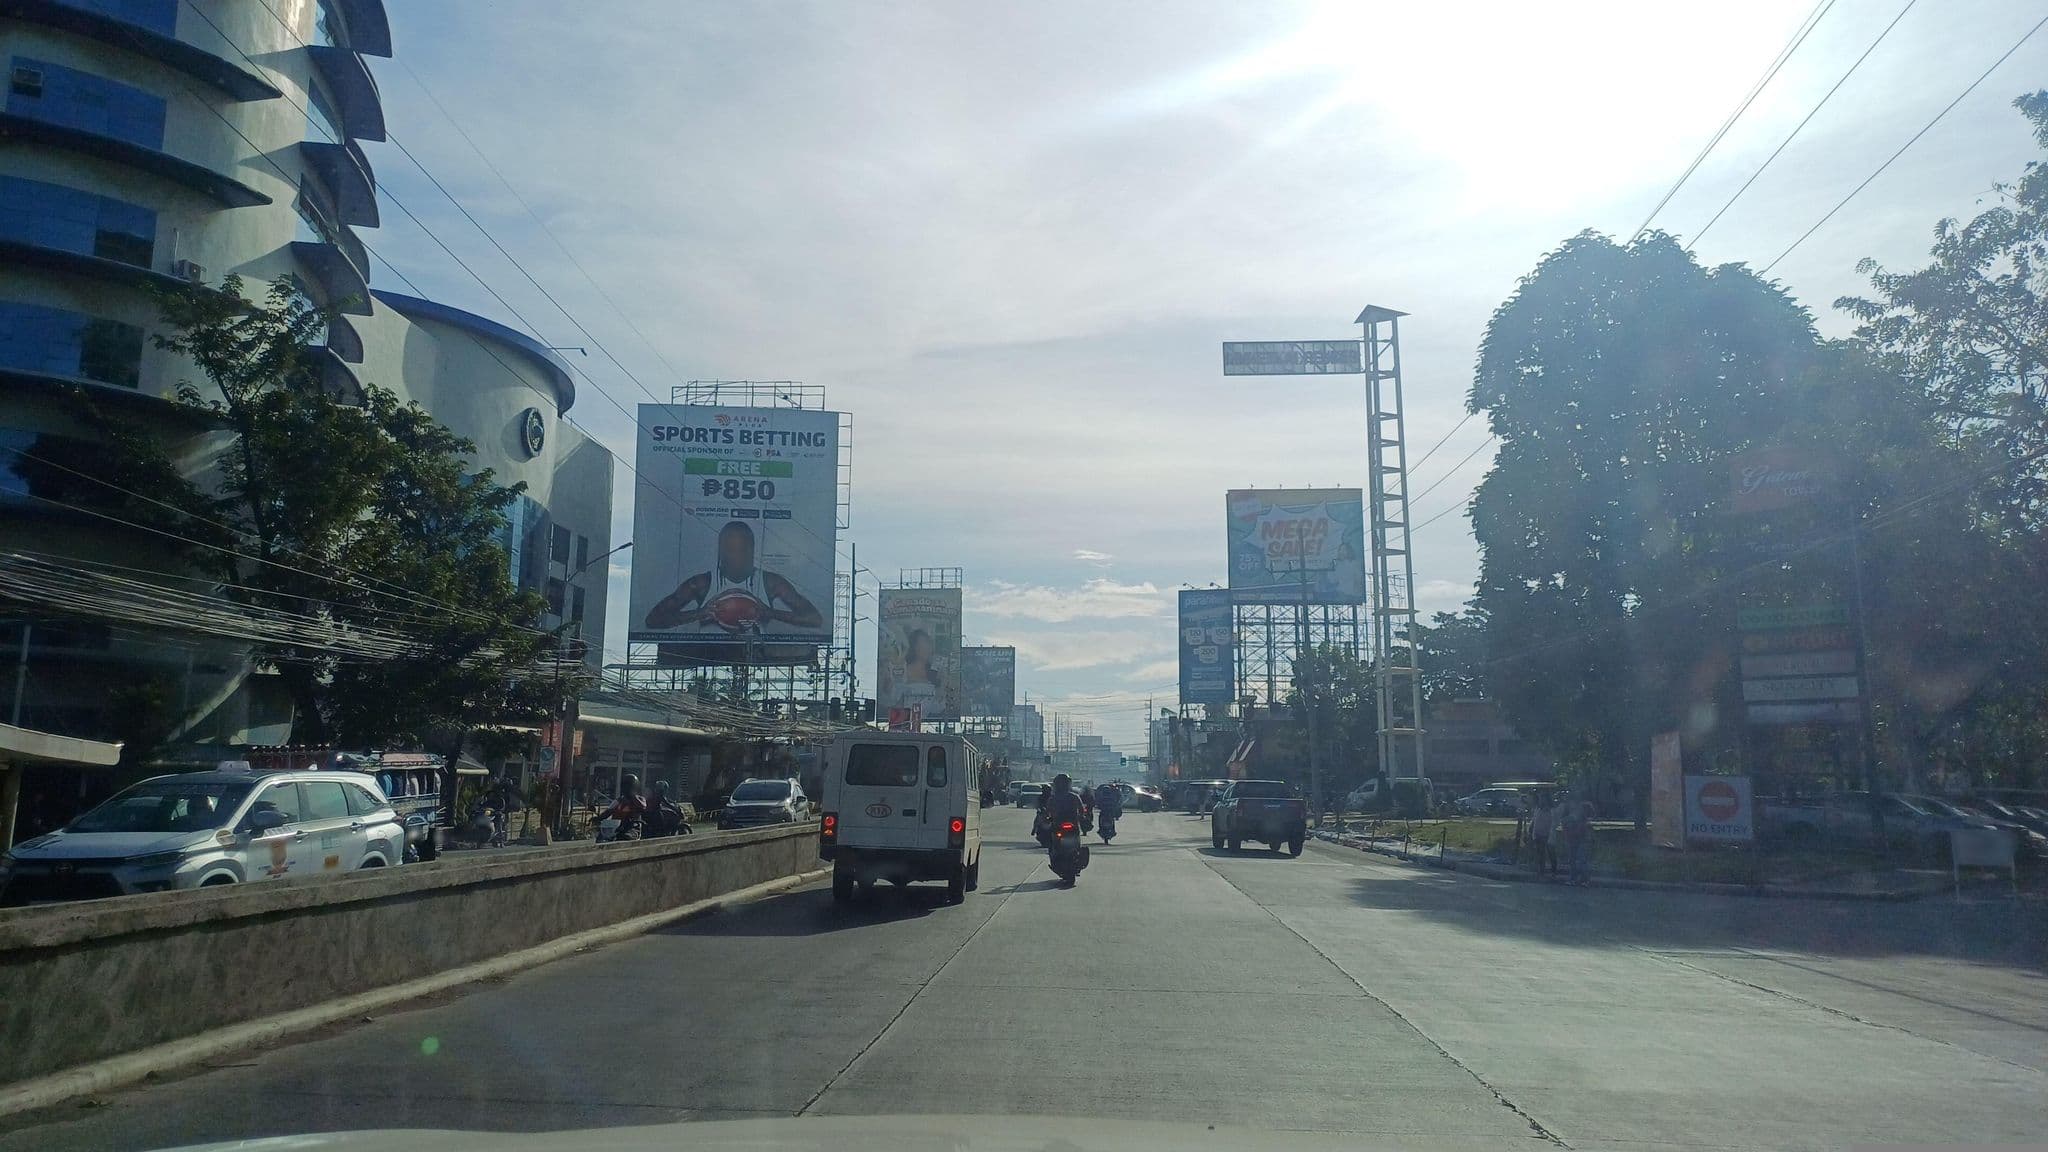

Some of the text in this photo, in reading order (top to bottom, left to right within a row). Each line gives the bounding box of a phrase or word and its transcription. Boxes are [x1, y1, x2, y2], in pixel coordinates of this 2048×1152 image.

[733, 415, 768, 424] ARENA
[652, 425, 826, 448] SPORTS BETTING
[652, 445, 734, 455] OFFICIAL SPONSOR OF
[716, 461, 761, 476] FREE
[1260, 517, 1329, 541] MEGA
[1267, 538, 1325, 558] SALE!
[1238, 561, 1261, 571] OFF
[1690, 823, 1749, 835] NO ENTRY
